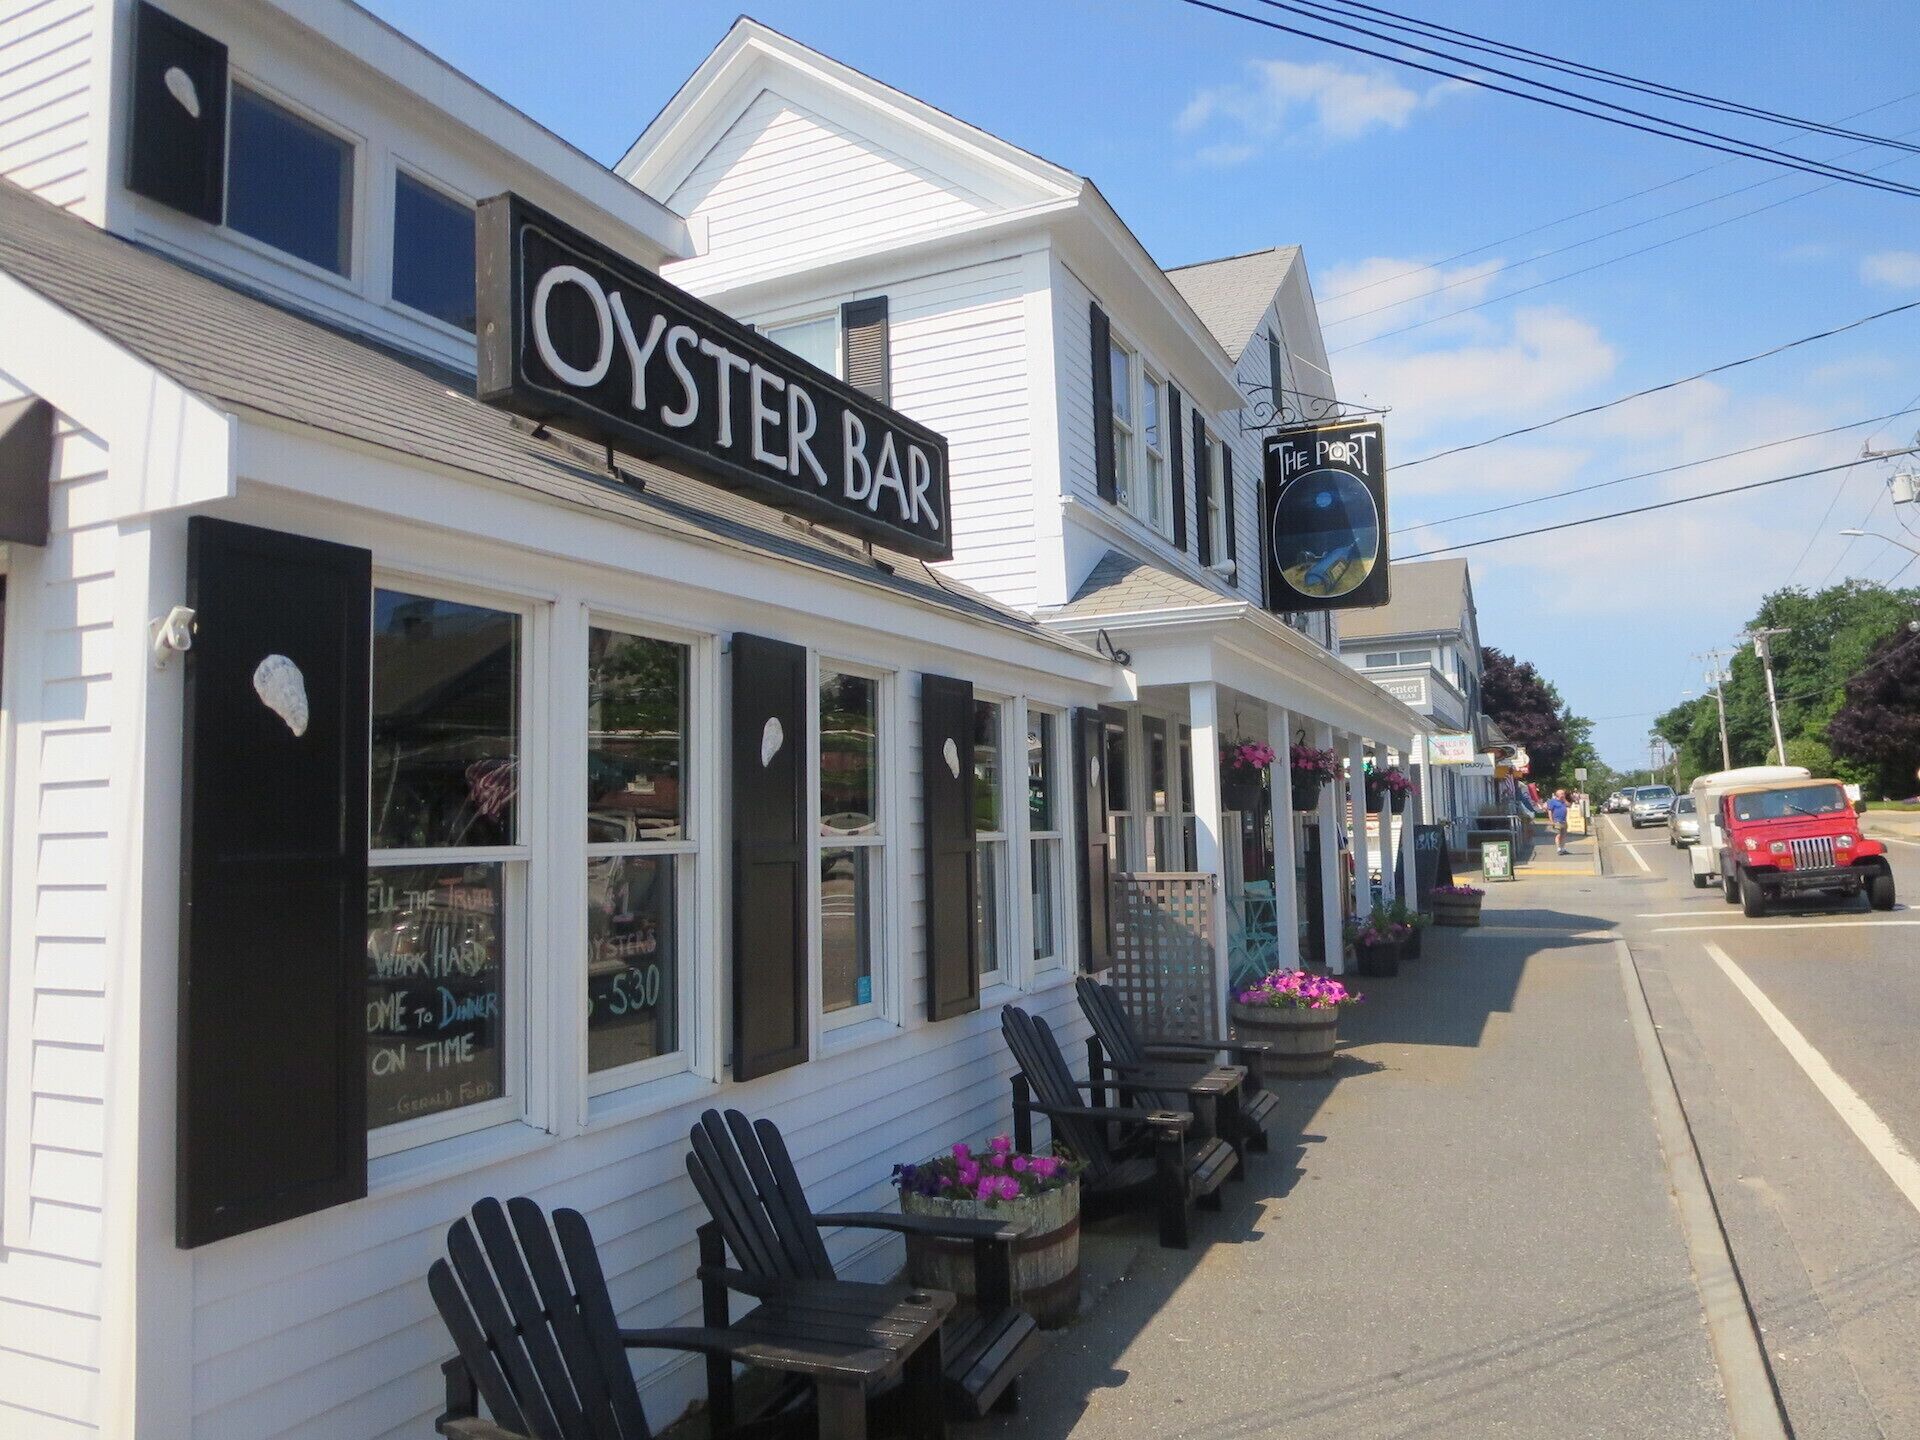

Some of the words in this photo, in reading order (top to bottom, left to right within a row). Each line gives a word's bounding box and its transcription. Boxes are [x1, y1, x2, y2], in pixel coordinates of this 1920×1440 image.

[532, 265, 828, 486] OYSTER
[842, 409, 939, 530] BAR
[1269, 442, 1310, 487] THE
[1316, 431, 1376, 476] PORT
[367, 879, 400, 914] ELL
[402, 890, 436, 911] THE
[588, 929, 657, 961] YSTERS
[367, 989, 408, 1032] OME
[436, 986, 499, 1029] DINNER
[371, 1043, 406, 1075] ON
[416, 1032, 474, 1072] TIME
